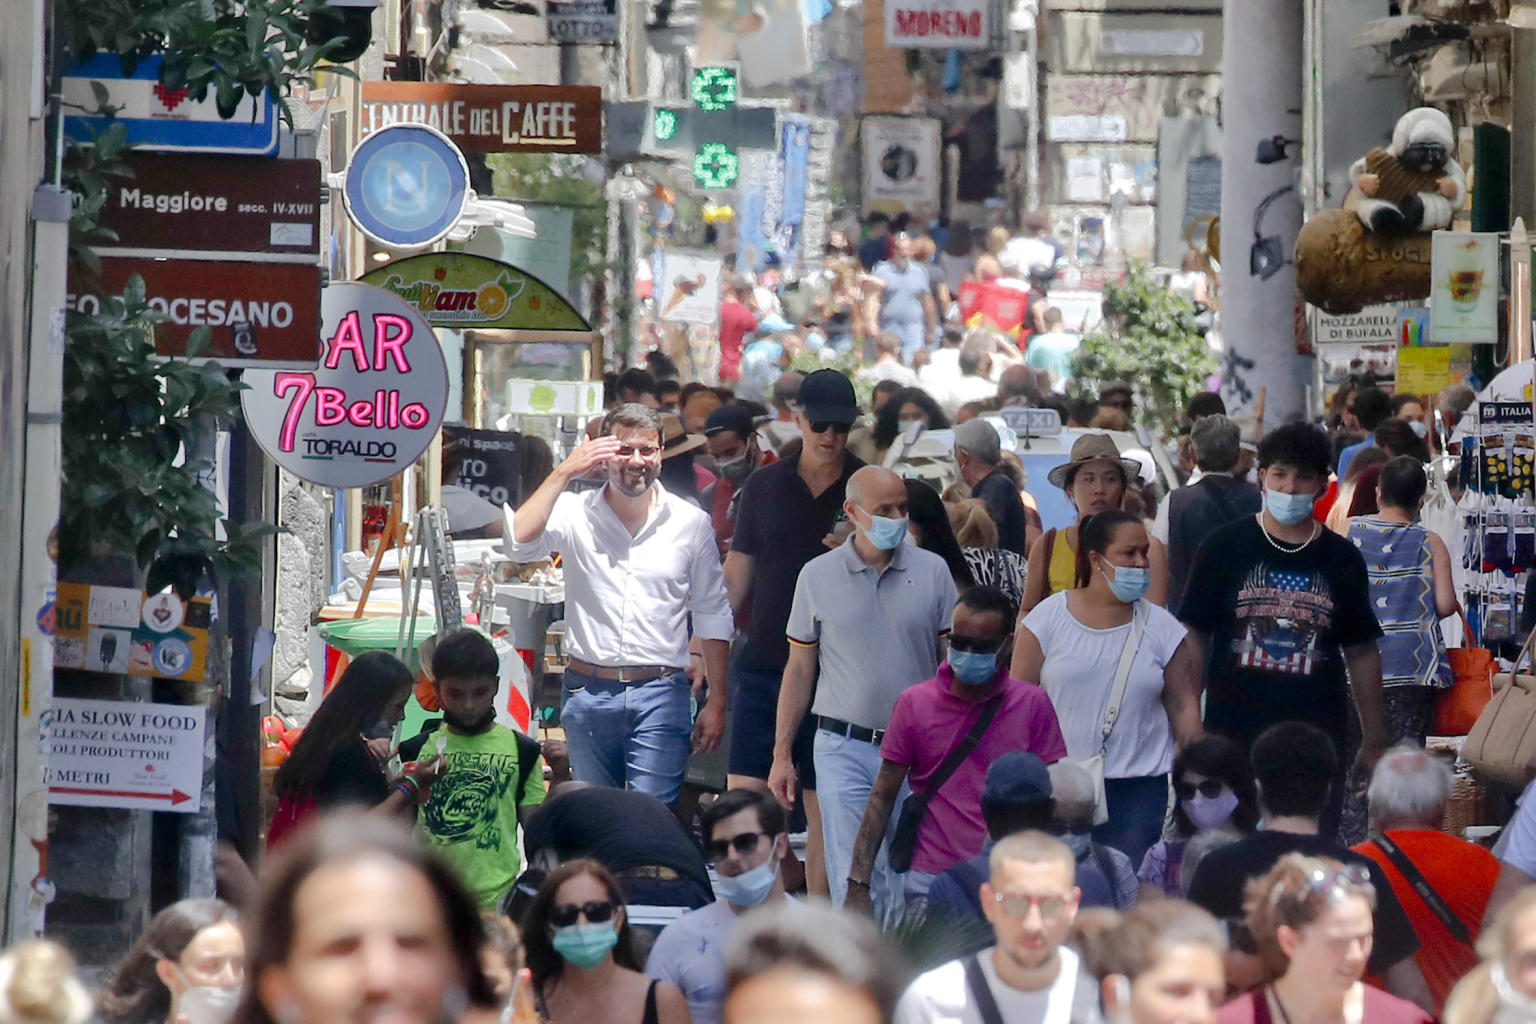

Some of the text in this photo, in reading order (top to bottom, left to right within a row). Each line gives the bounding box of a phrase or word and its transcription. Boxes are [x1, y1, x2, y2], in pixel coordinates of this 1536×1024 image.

[895, 10, 982, 37] MORENO
[470, 108, 499, 135] DEL
[120, 188, 228, 213] Maggiore
[237, 203, 268, 214] secc.
[319, 310, 413, 373] AR
[1330, 330, 1392, 339] DI BUFALA
[273, 371, 430, 452] 7 Bello
[1004, 412, 1052, 427] TAXI
[1501, 406, 1532, 416] ITALIA
[302, 437, 397, 458] TORALDO
[81, 710, 135, 727] SLOW
[141, 714, 196, 731] FOOD
[112, 731, 177, 745] CAMPANE
[80, 745, 169, 761] PRODUTTORI
[57, 769, 110, 785] METRI
